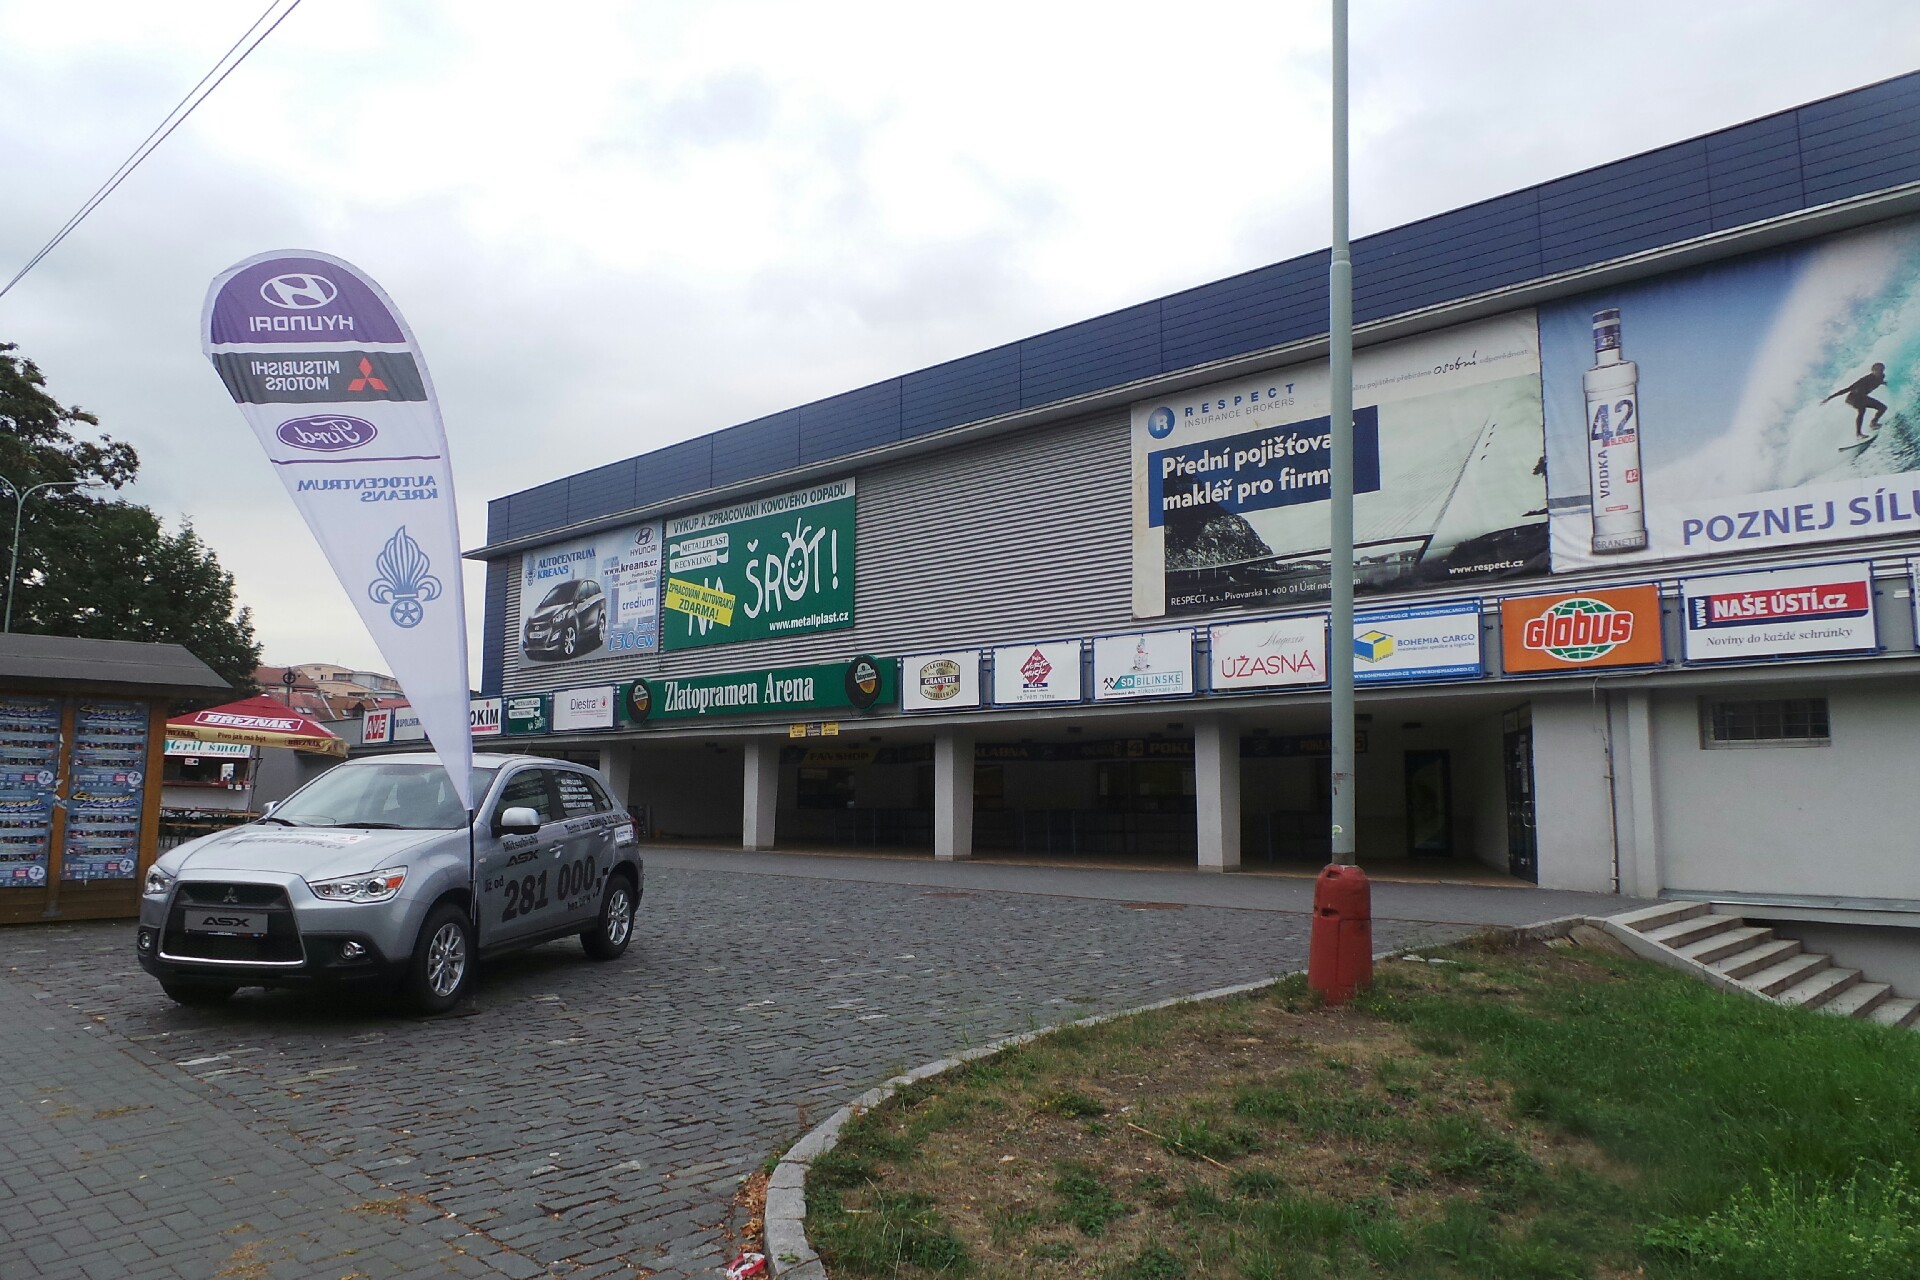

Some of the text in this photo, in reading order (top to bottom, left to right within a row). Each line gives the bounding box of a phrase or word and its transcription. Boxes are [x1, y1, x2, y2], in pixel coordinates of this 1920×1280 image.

[1185, 383, 1295, 417] RESPECT
[1155, 414, 1169, 432] R
[1184, 397, 1295, 429] INSURANCE BROKERS
[1591, 399, 1635, 447] 42
[1162, 430, 1332, 479] Přední pojišťova
[1597, 449, 1611, 499] VODKA
[1626, 469, 1638, 483] 42
[1162, 466, 1331, 511] makléř pro firm
[674, 483, 847, 534] VÝKUP A ZPRACOVÁNÍ KOVOVÉHO ODPADU
[1682, 501, 1835, 546] POZNEJ
[629, 545, 657, 557] HYUNDAI
[682, 536, 727, 553] METALLPLAST
[537, 548, 596, 569] AUTOCENTRUM
[604, 559, 657, 576] www.kreans.cz
[674, 555, 712, 569] RECYKLING
[1449, 559, 1524, 575] www.respect.cz
[537, 565, 569, 579] KREANS
[1225, 585, 1263, 603] Pivovarská
[1272, 585, 1288, 596] 400
[1289, 583, 1298, 594] 01
[1299, 577, 1316, 592] Ústí
[622, 595, 654, 610] credium
[679, 598, 719, 620] ZDARMA!
[1714, 587, 1847, 619] NAŠE ÚSTÍ.cz
[769, 611, 849, 631] www.metallplast.cz
[1696, 599, 1705, 628] www
[1397, 633, 1475, 647] BOHEMIA CARGO
[1706, 627, 1853, 647] Noviny do každé schránky
[1221, 650, 1316, 679] ÚŽASNÁ
[924, 676, 956, 685] GRANETTE
[1120, 678, 1134, 687] SD
[664, 672, 815, 714] Zlatopramen Arena
[570, 698, 596, 710] Diestra
[232, 733, 243, 741] jak
[366, 714, 387, 741] AVE
[170, 740, 202, 751] Gril
[503, 834, 539, 852] Mitsubishi
[506, 849, 540, 867] ASX
[494, 874, 503, 888] od
[502, 869, 549, 922] 281
[202, 916, 250, 928] ASX
